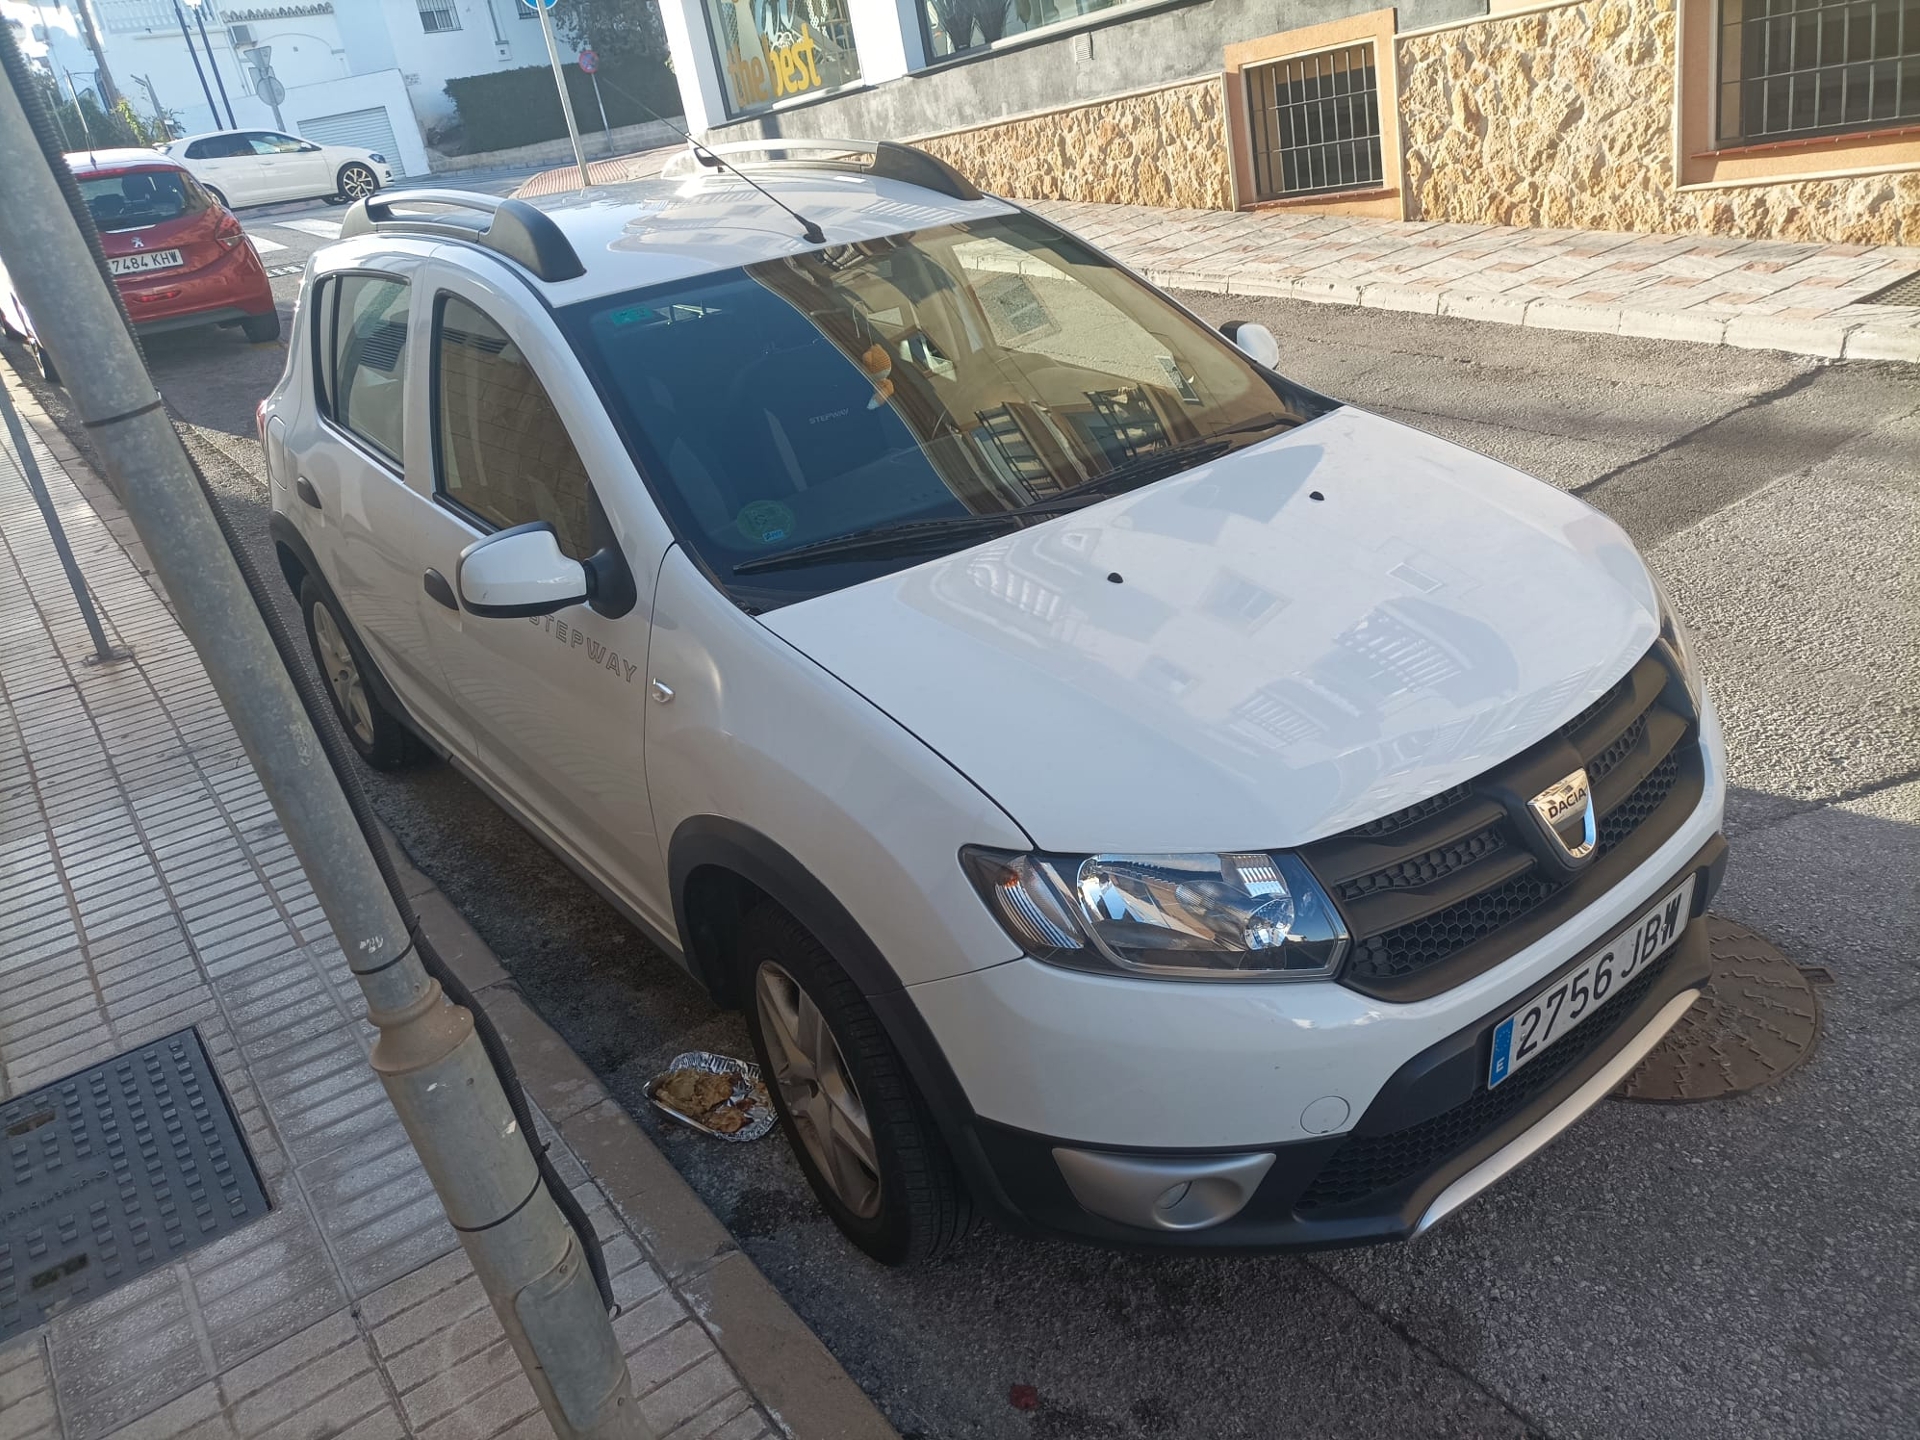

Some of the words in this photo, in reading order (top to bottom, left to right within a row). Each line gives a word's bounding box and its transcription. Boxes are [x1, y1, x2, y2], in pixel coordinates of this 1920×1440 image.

[727, 43, 768, 108] the
[761, 23, 822, 97] best
[112, 256, 148, 272] 7484
[151, 251, 178, 266] KHW
[1548, 788, 1586, 819] DACIA
[1496, 1056, 1504, 1072] E
[1516, 952, 1614, 1060] 2756
[1621, 893, 1682, 978] JBW
